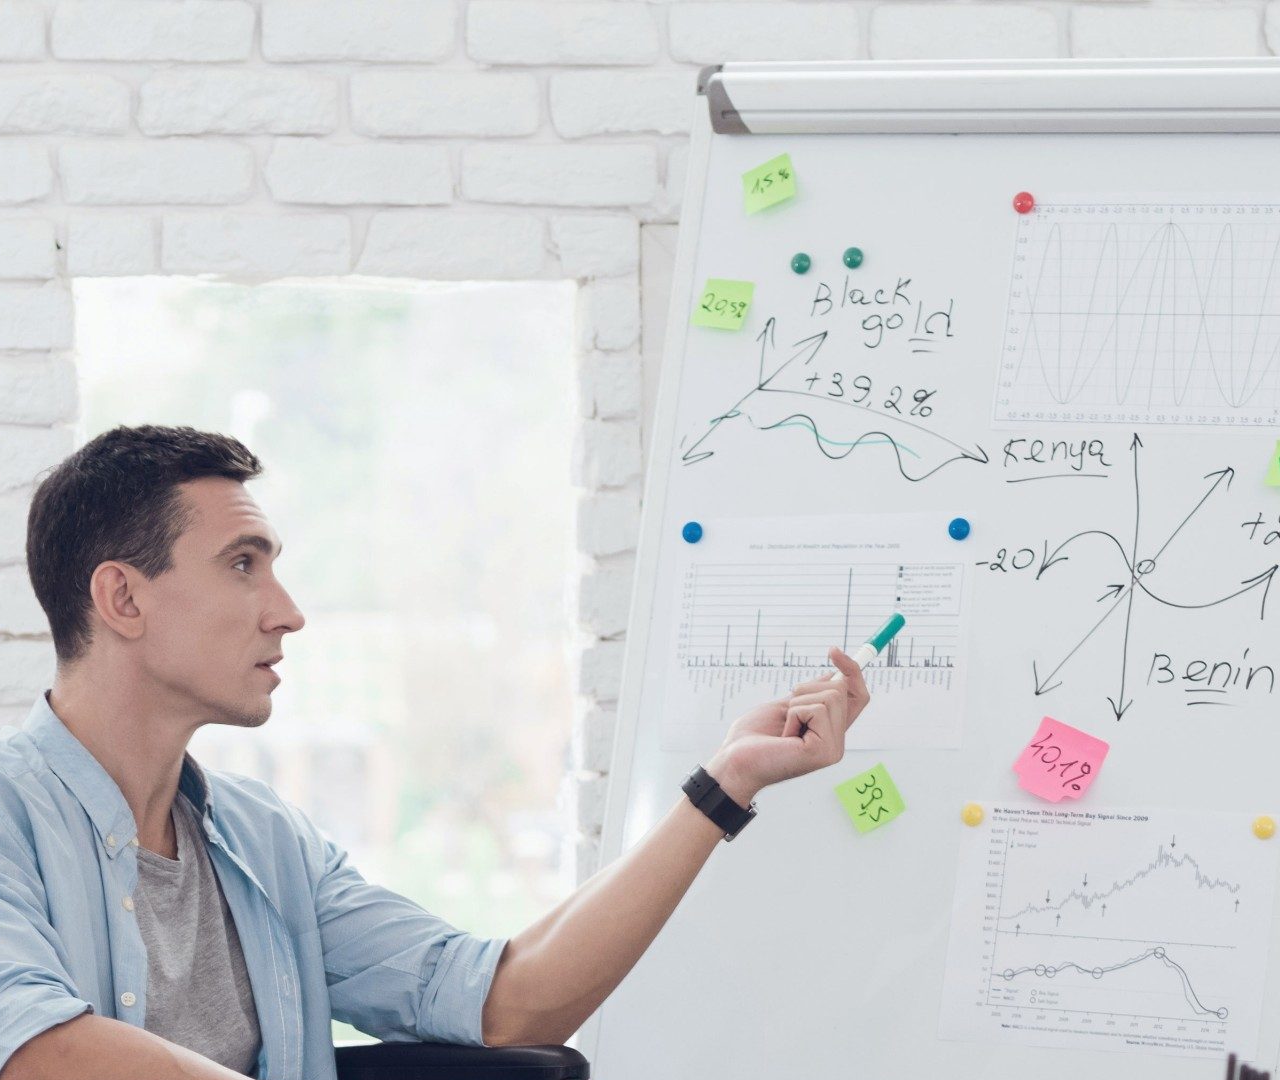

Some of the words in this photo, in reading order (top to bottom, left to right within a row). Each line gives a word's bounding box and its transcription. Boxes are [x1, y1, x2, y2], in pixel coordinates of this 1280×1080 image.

[811, 275, 912, 317] Black
[860, 300, 955, 348] gold
[805, 372, 938, 418] +39,2%
[1004, 438, 1113, 471] Kenya
[975, 548, 1035, 573] -20
[1147, 648, 1275, 693] Benin
